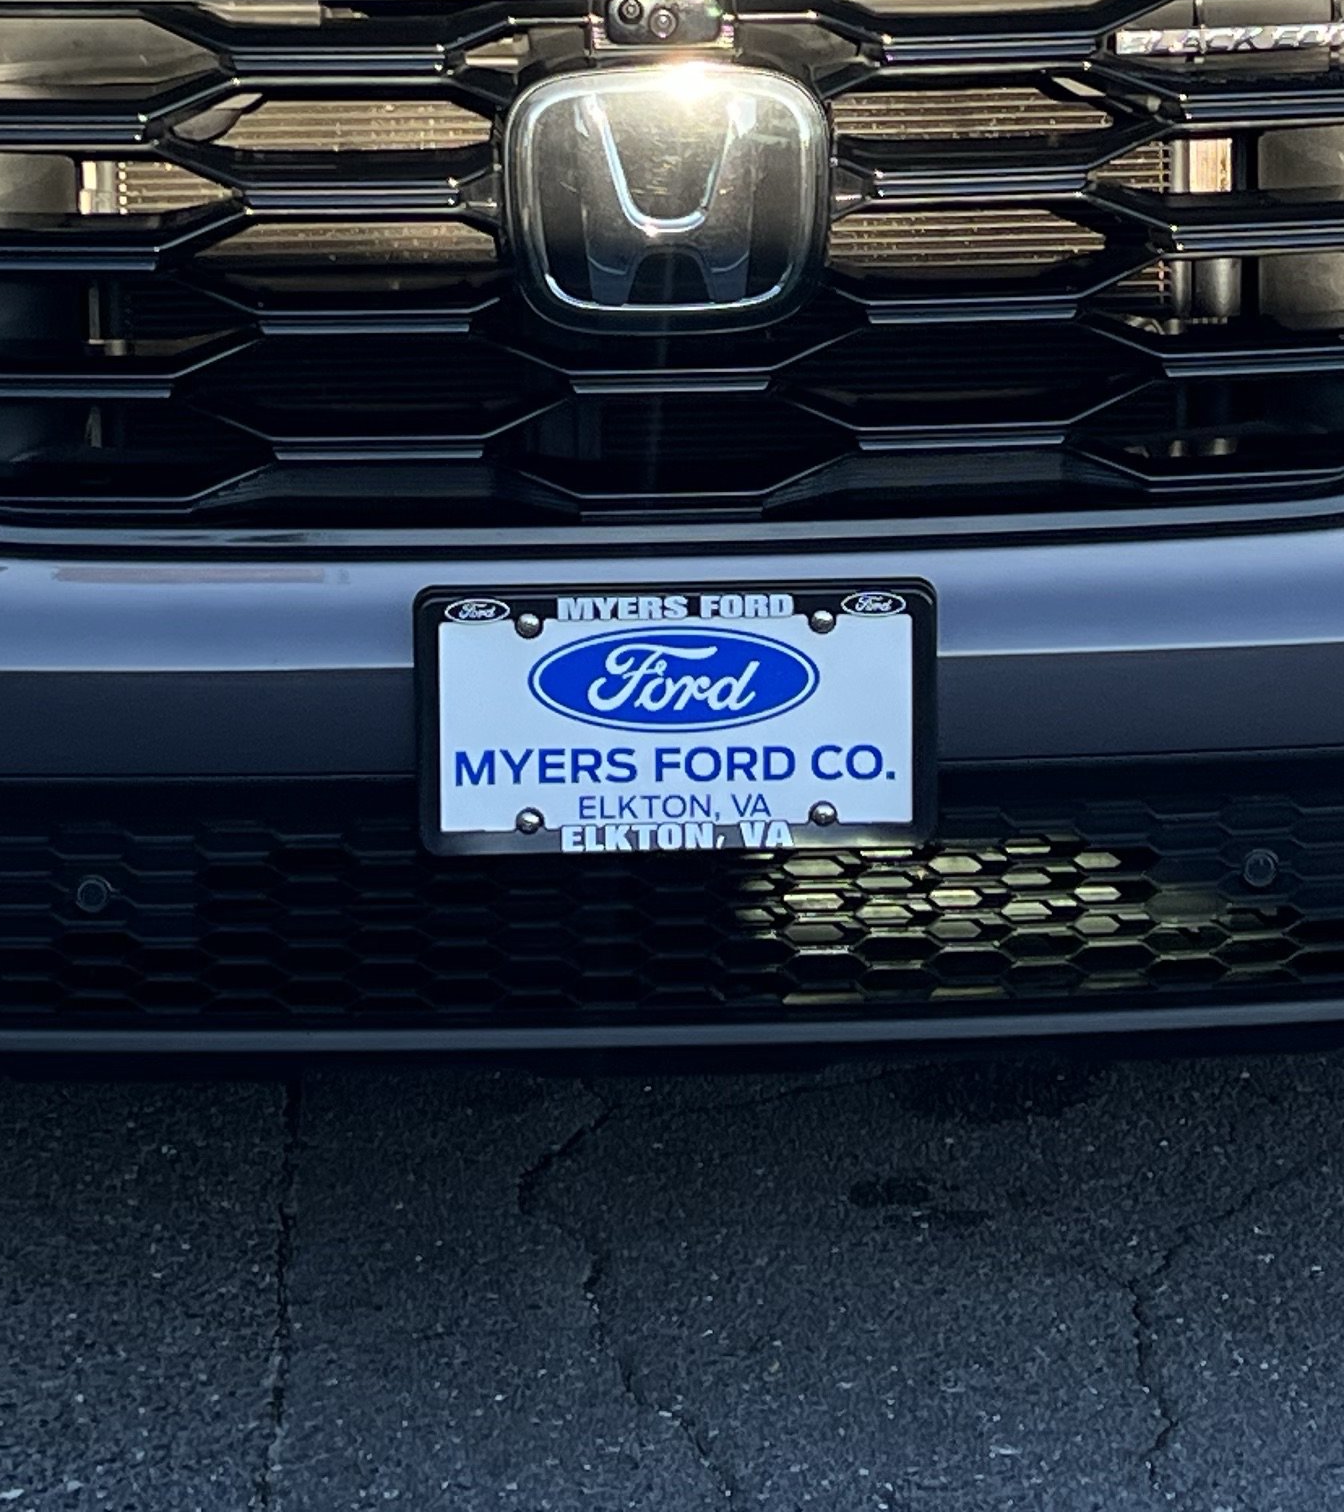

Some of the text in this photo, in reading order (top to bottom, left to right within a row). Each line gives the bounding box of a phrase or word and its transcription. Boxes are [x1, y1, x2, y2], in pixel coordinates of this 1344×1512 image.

[1117, 25, 1263, 55] BLACK
[458, 602, 496, 620] Ford
[557, 593, 794, 620] MYERS FORD
[855, 594, 893, 612] Ford
[587, 643, 760, 711] Ford
[455, 743, 896, 786] MYERS FORD CO.
[578, 792, 772, 820] ELKTON, VA
[560, 820, 795, 852] ELKTON, VA
